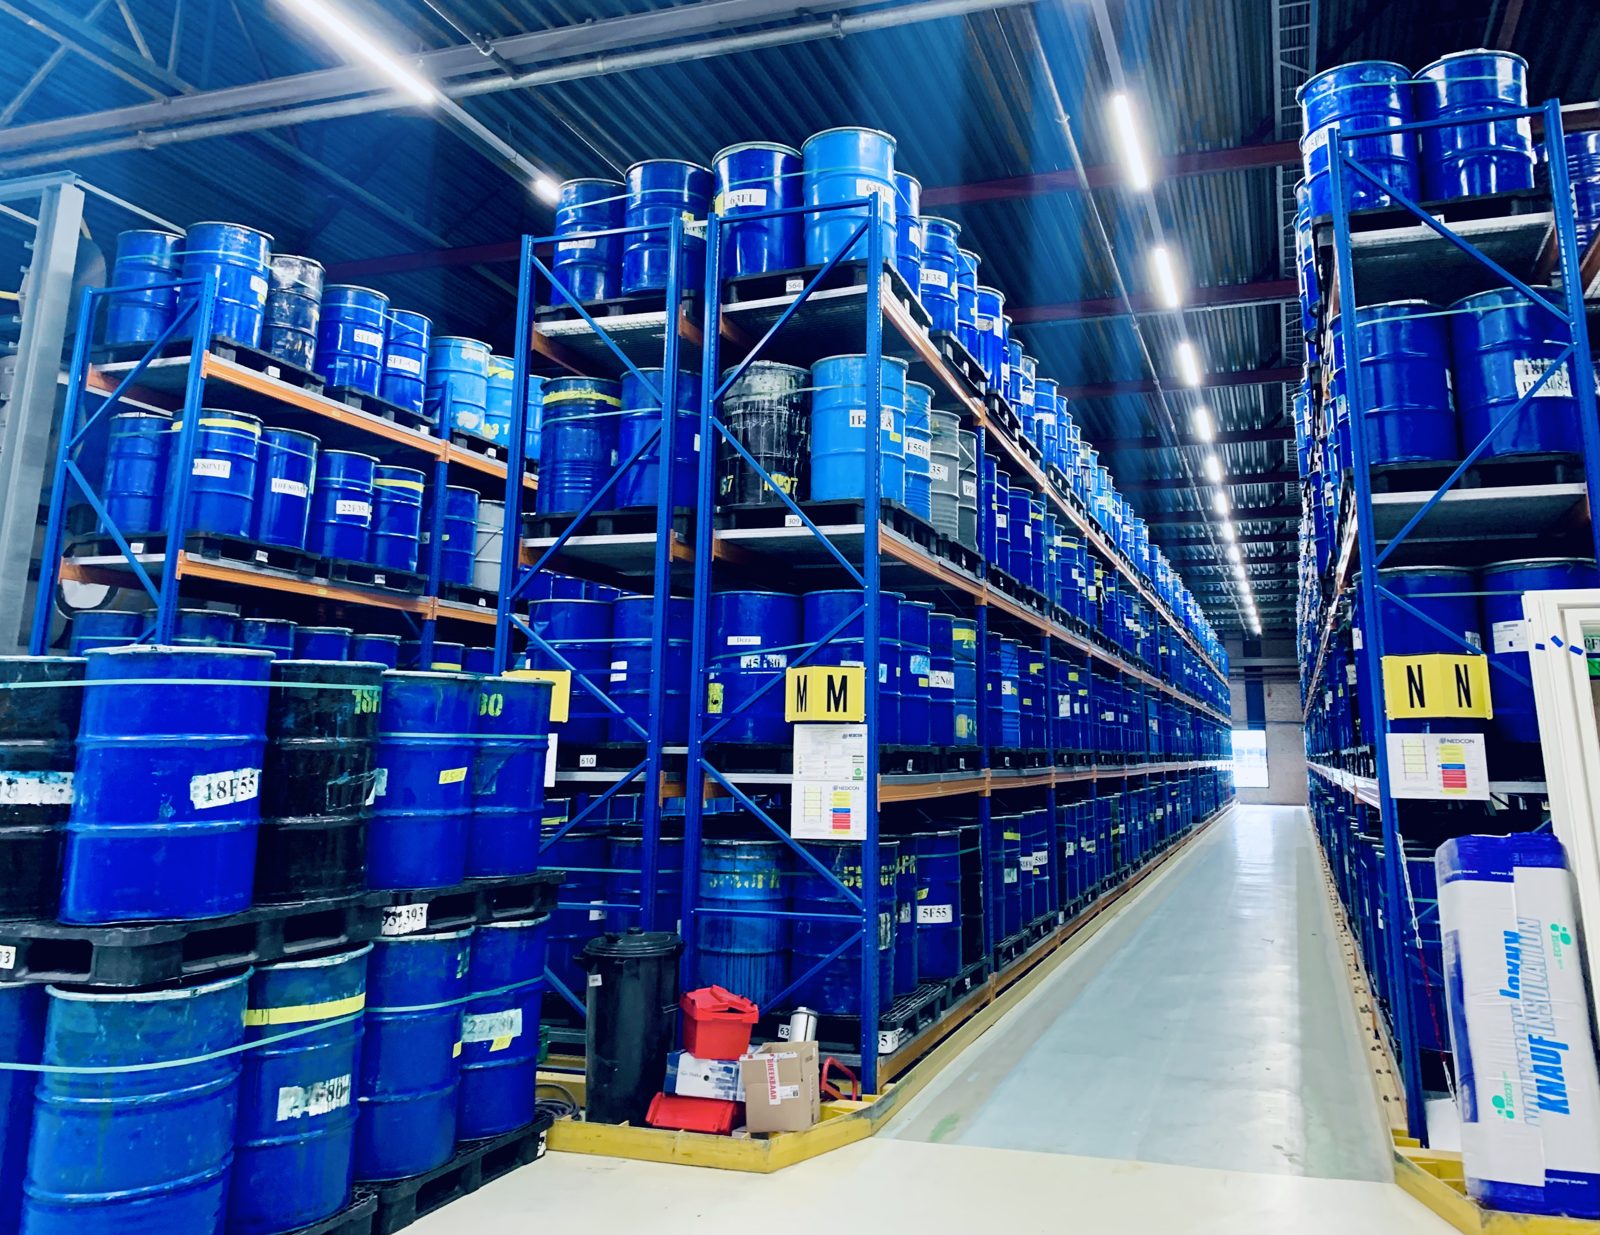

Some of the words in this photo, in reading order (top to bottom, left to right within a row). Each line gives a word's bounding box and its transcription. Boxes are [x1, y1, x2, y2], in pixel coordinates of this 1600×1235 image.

[796, 674, 808, 713] M
[826, 674, 848, 713] M
[1406, 663, 1426, 709] N
[1454, 663, 1473, 709] N
[205, 774, 256, 802] 18F55
[922, 907, 948, 919] 5F55
[1517, 915, 1557, 1037] INSULATION
[1528, 1033, 1569, 1115] KNAUF
